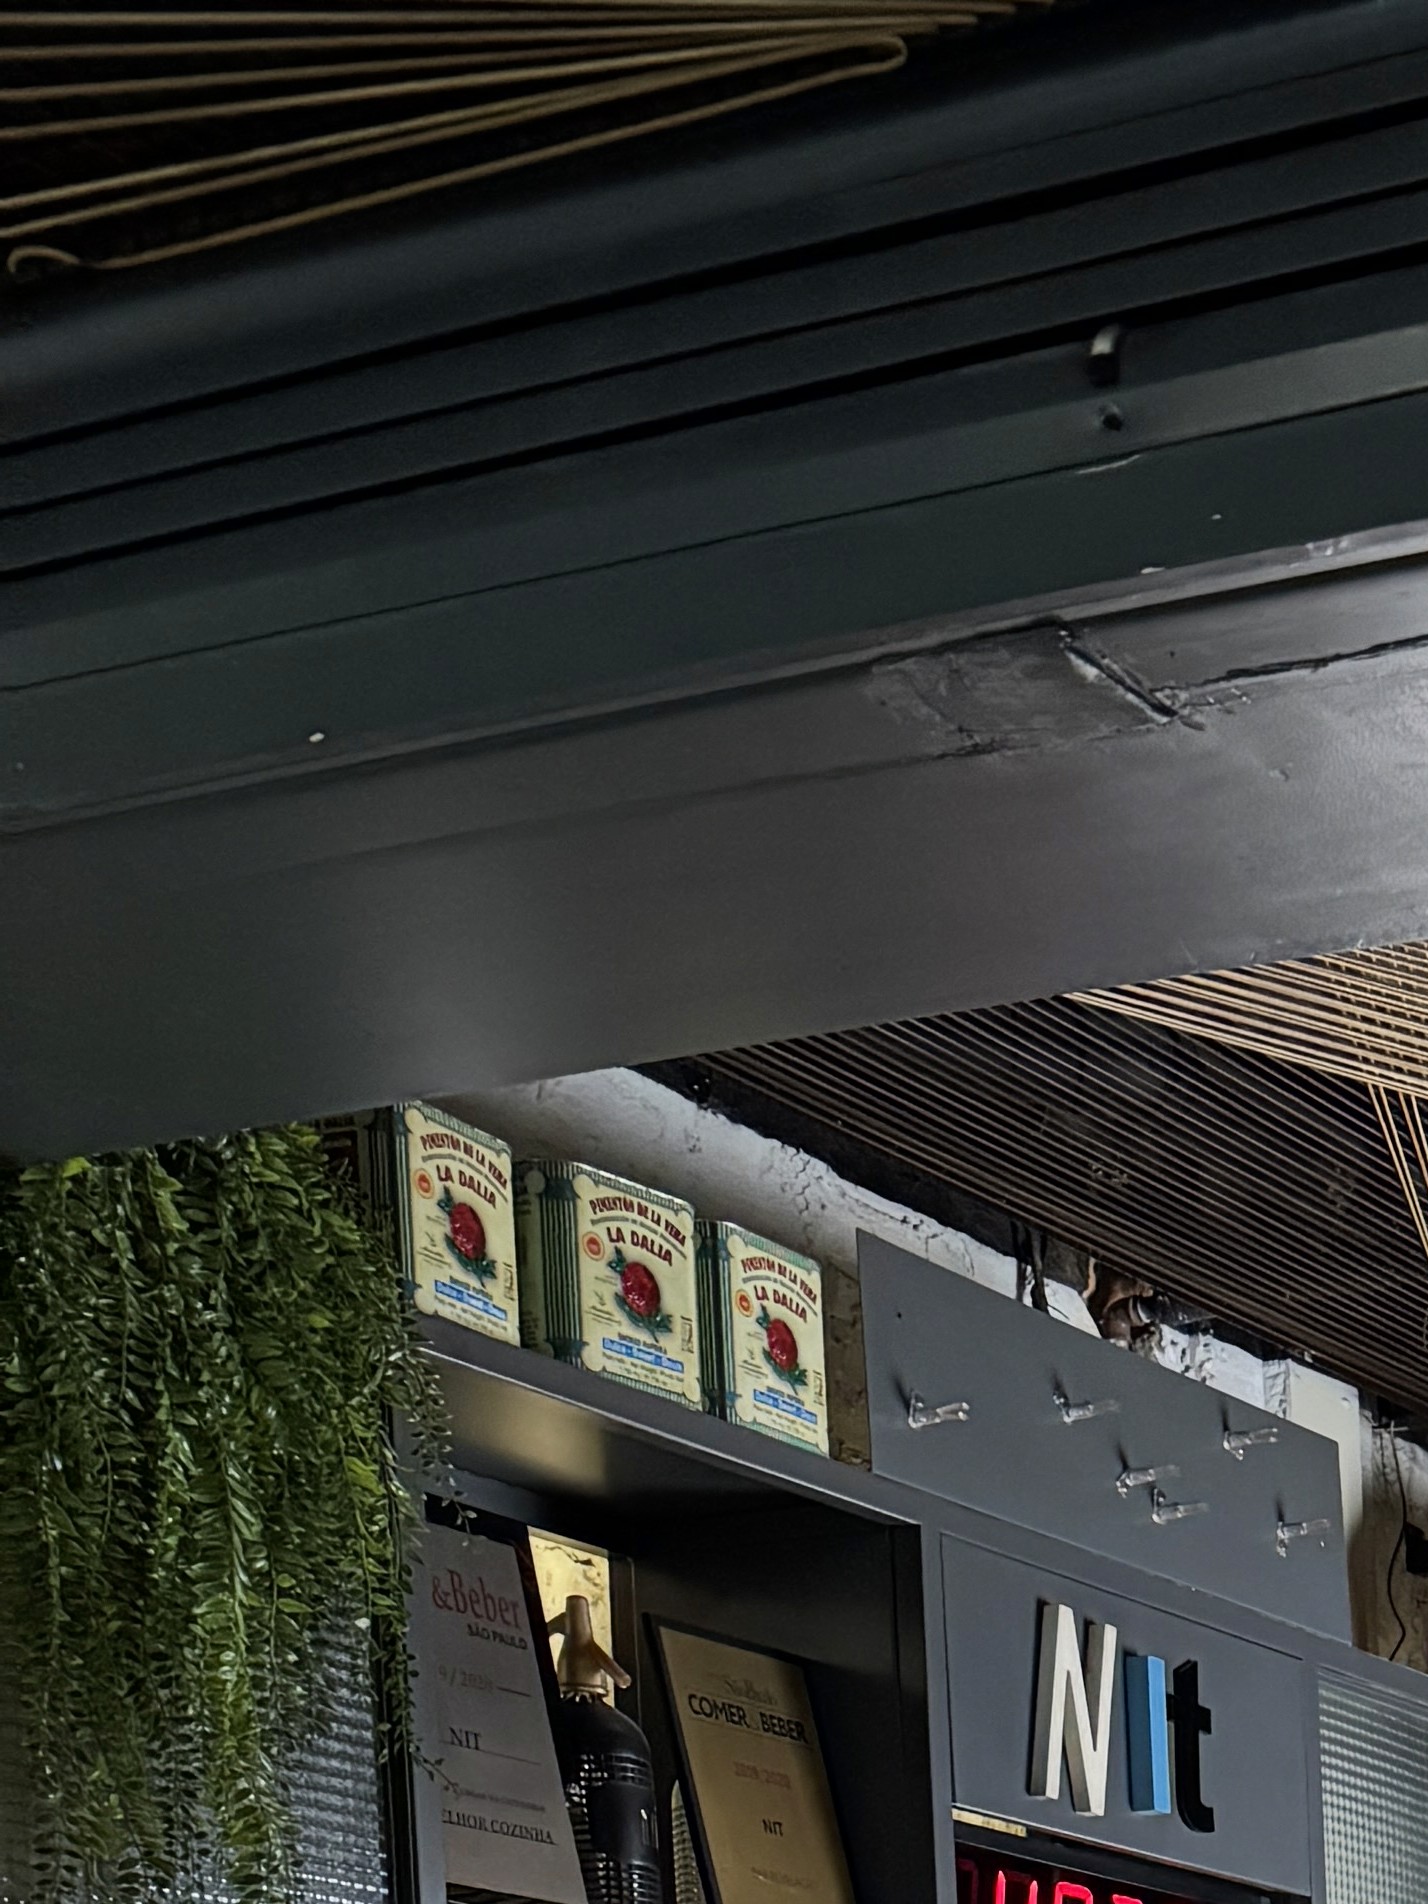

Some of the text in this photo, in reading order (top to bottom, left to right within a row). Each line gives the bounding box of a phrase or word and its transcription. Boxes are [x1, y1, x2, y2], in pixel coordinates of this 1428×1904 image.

[436, 1164, 454, 1184] LA
[458, 1169, 497, 1209] DALIA
[606, 1226, 625, 1244] LA
[630, 1230, 673, 1267] DALIA
[754, 1285, 770, 1302] LA
[772, 1289, 808, 1324] DALIA
[449, 1726, 482, 1751] NIT
[442, 1808, 556, 1845] ELHOR COZINHA
[762, 1819, 784, 1837] NIT
